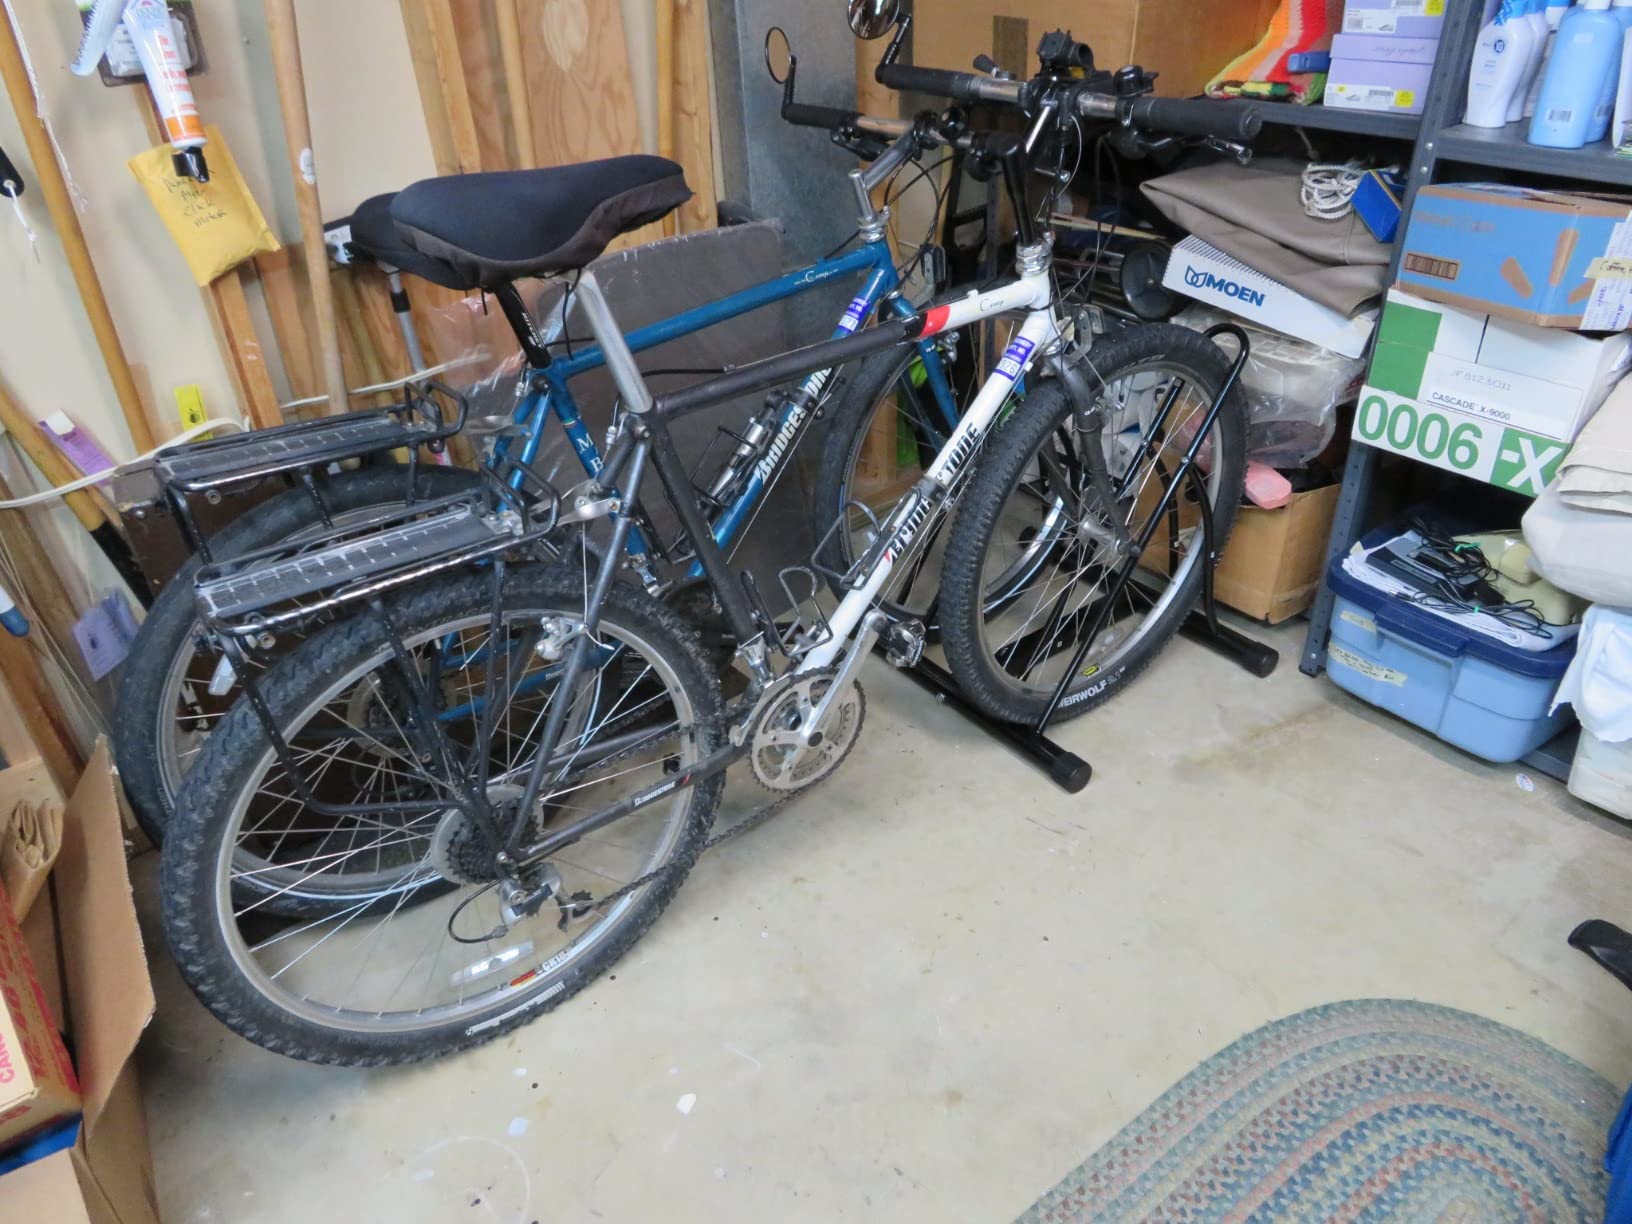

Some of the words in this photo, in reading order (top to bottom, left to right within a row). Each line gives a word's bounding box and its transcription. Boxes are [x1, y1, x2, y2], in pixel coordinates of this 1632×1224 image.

[1205, 273, 1266, 308] MOEN
[753, 367, 833, 486] BRIDGESON
[1358, 394, 1484, 471] 0006
[1432, 392, 1476, 411] CASCADE
[1479, 405, 1512, 421] X-9000
[888, 421, 979, 561] BRIDGTONE
